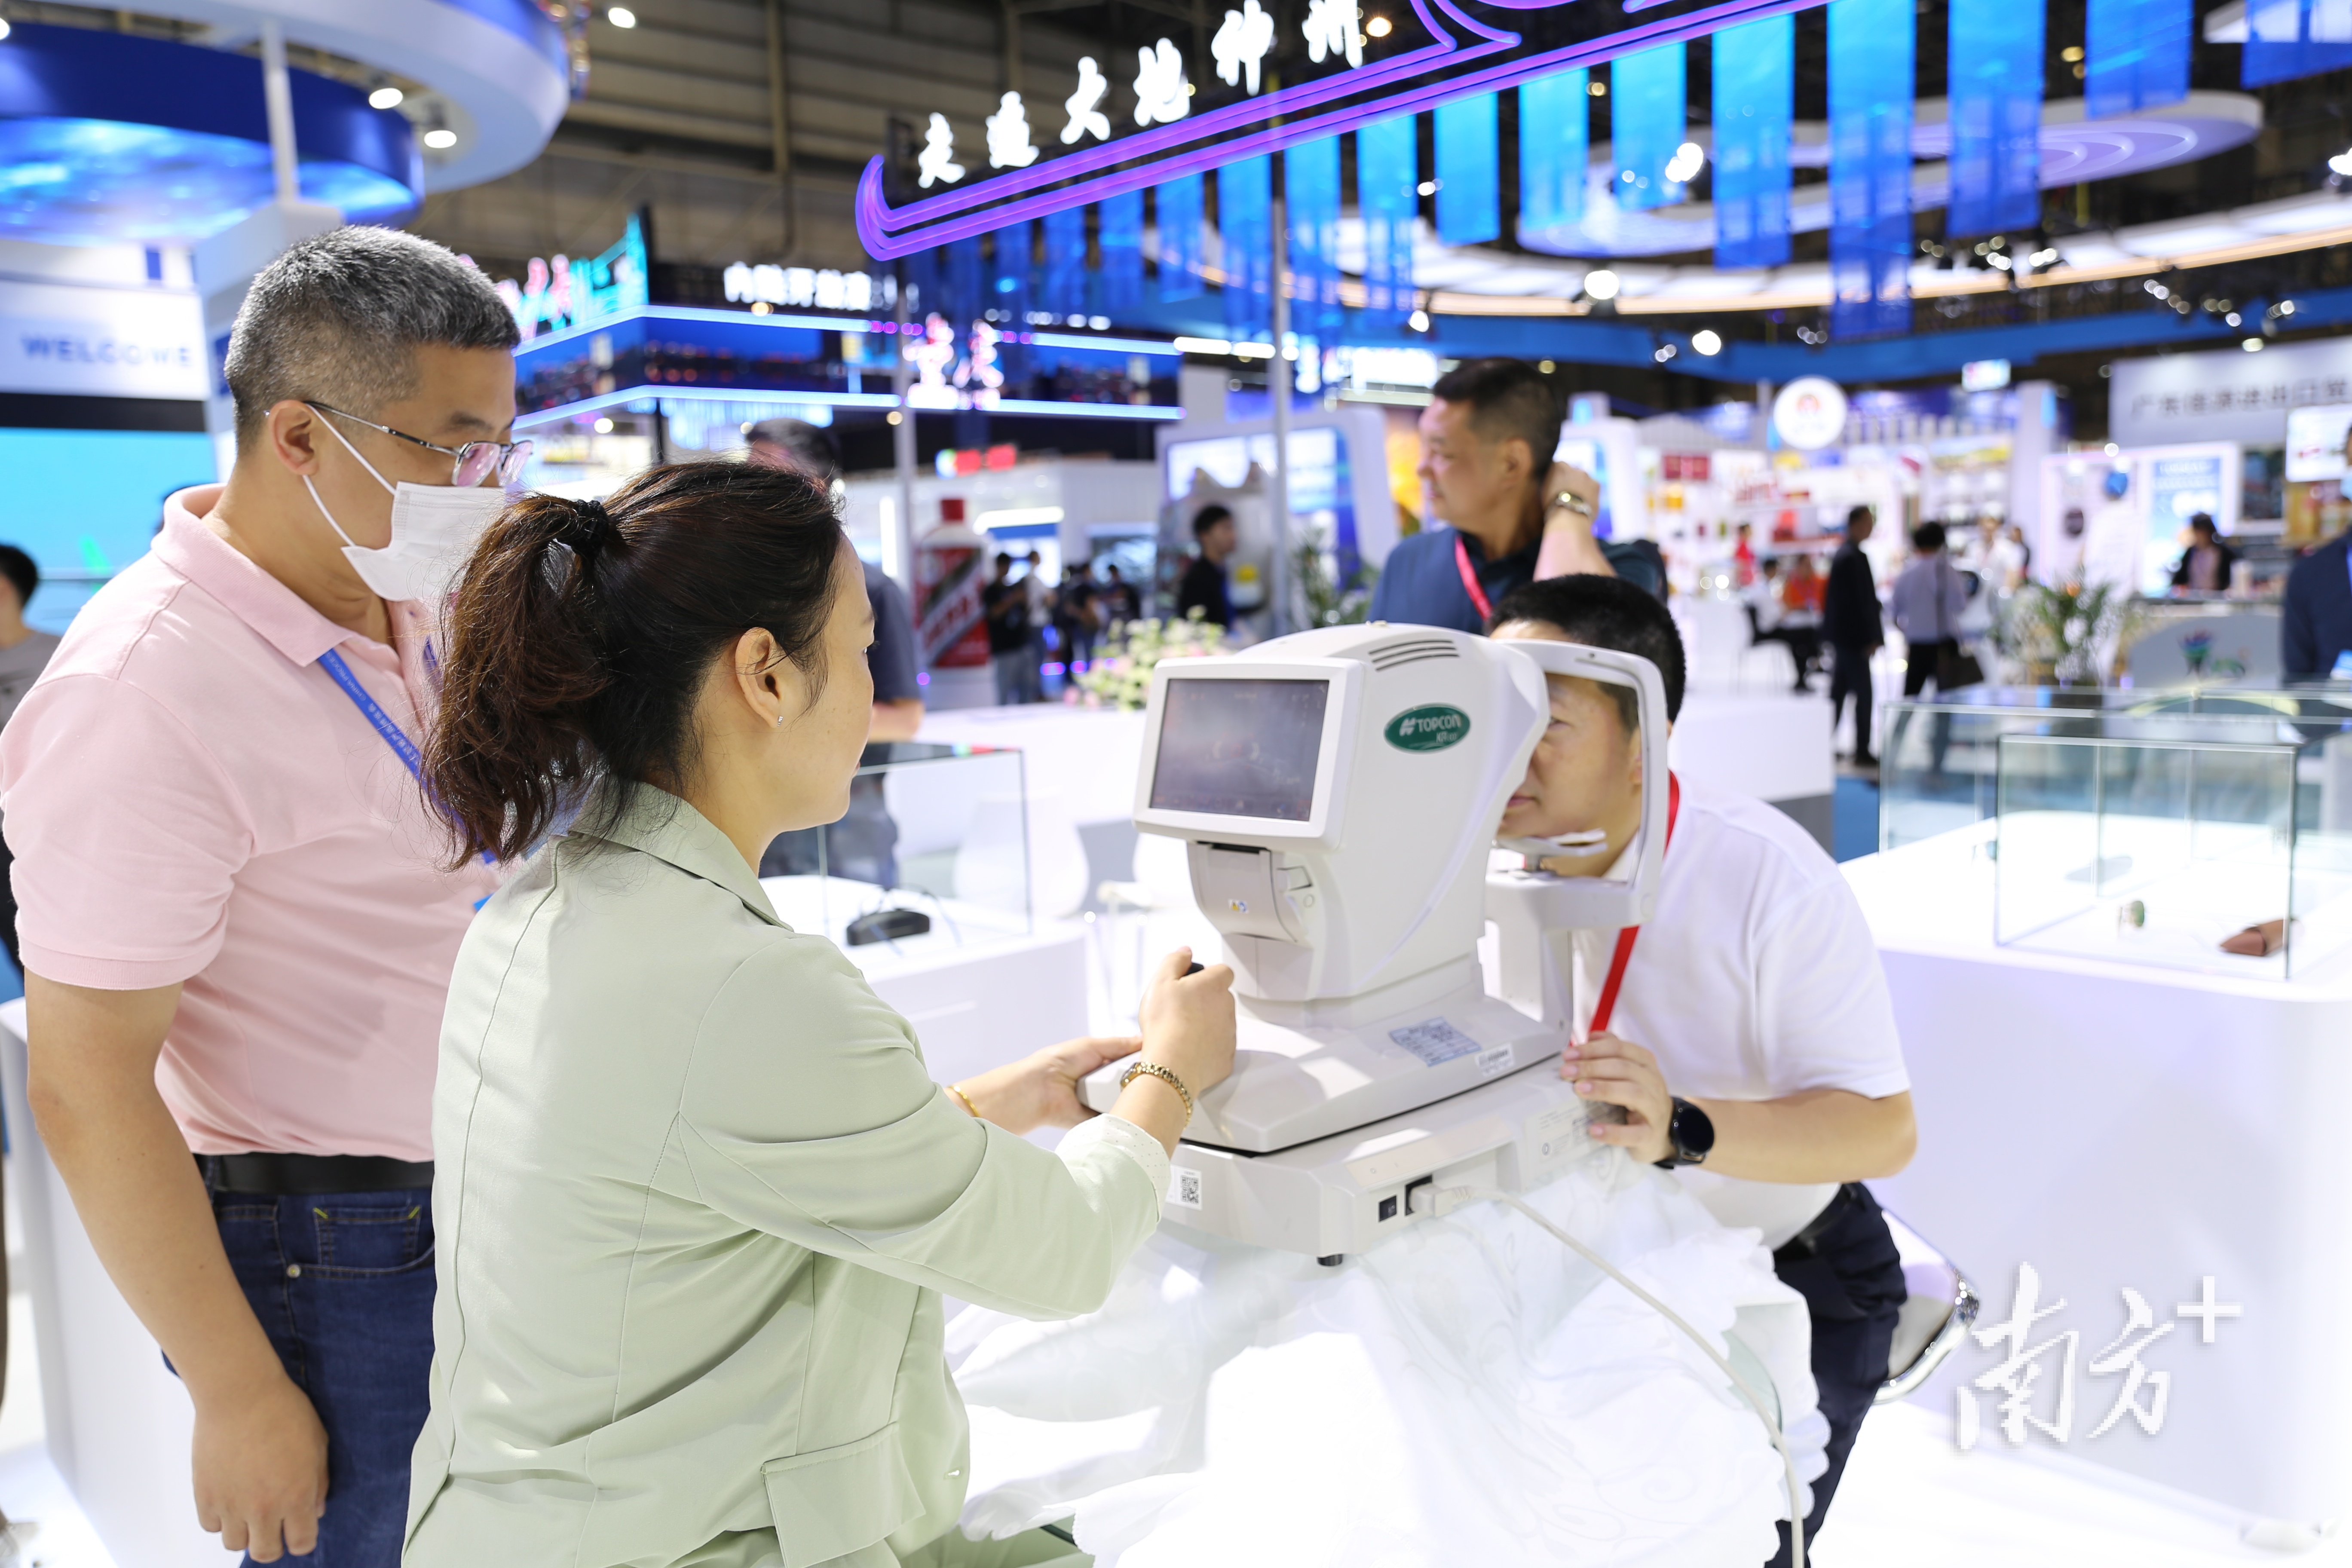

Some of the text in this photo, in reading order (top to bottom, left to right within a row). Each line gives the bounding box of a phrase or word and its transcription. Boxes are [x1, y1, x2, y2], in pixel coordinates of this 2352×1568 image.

[323, 650, 367, 702] CHINA PROCES
[1418, 714, 1461, 732] TOPCON
